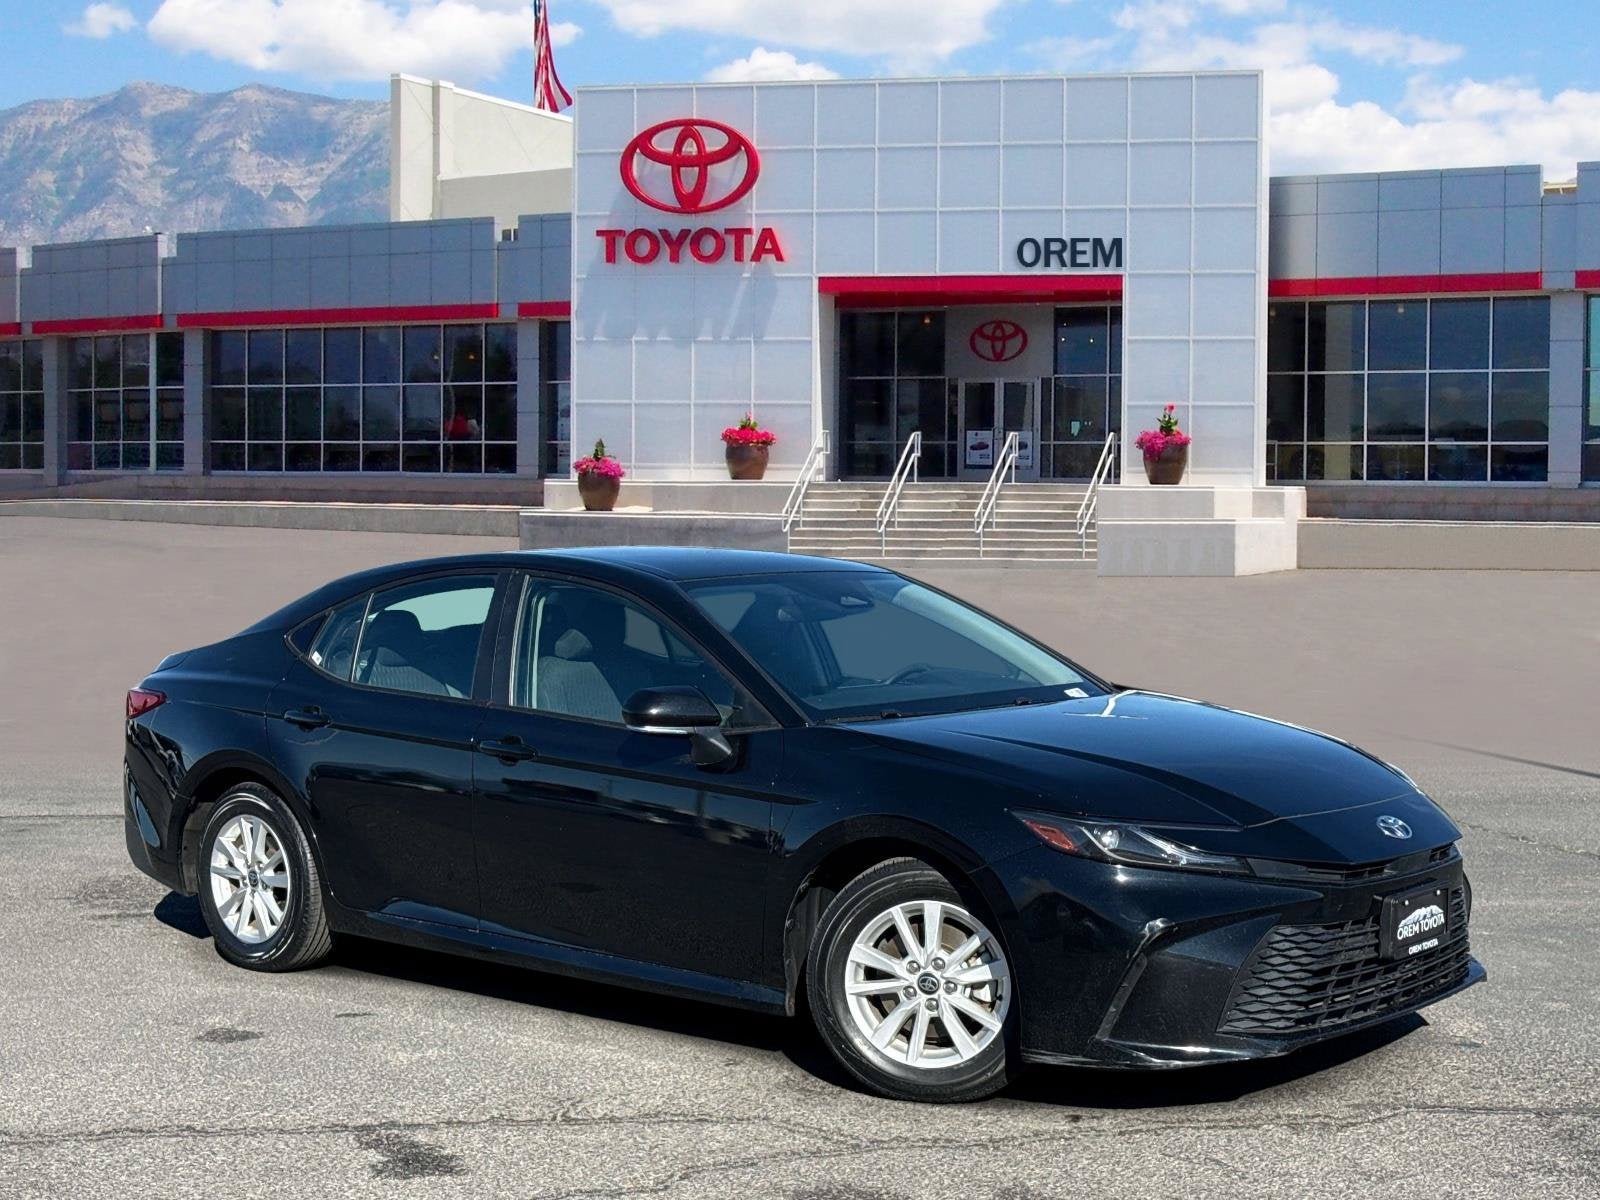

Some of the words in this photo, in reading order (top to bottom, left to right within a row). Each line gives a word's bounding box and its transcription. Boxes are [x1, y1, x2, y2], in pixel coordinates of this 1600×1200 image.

[596, 227, 784, 264] TOYOTA
[1016, 237, 1123, 268] OREM
[1397, 922, 1419, 940] OREM
[1420, 913, 1444, 932] TOYOTA
[1409, 944, 1421, 954] OREM
[1422, 938, 1438, 950] TOYOTA
